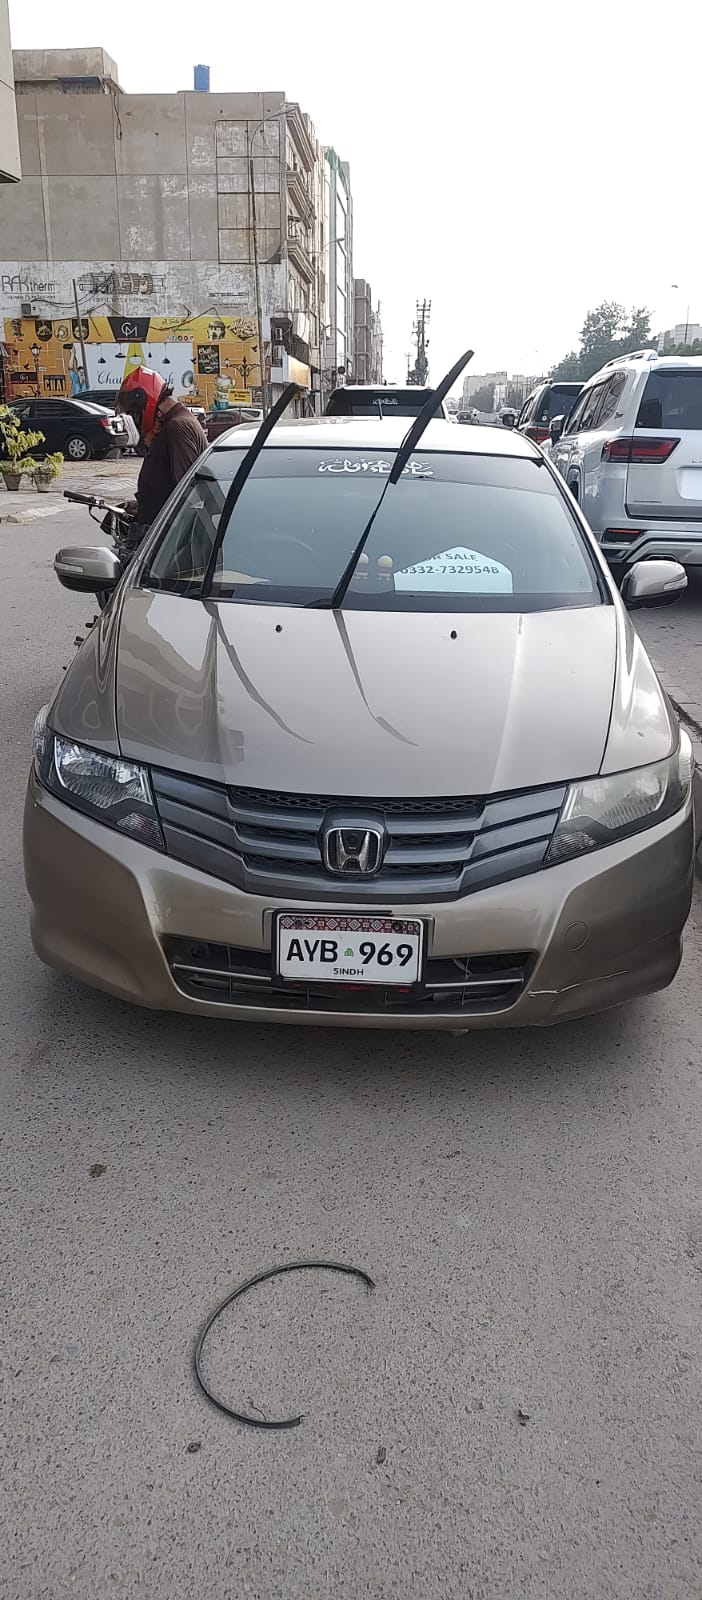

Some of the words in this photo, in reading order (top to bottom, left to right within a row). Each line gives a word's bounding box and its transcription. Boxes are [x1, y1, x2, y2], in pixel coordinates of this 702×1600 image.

[121, 322, 138, 337] CM
[44, 379, 66, 391] CHAI
[445, 553, 478, 562] SALE
[286, 938, 338, 963] AYB
[358, 941, 414, 967] 969
[333, 967, 364, 976] SINDH
